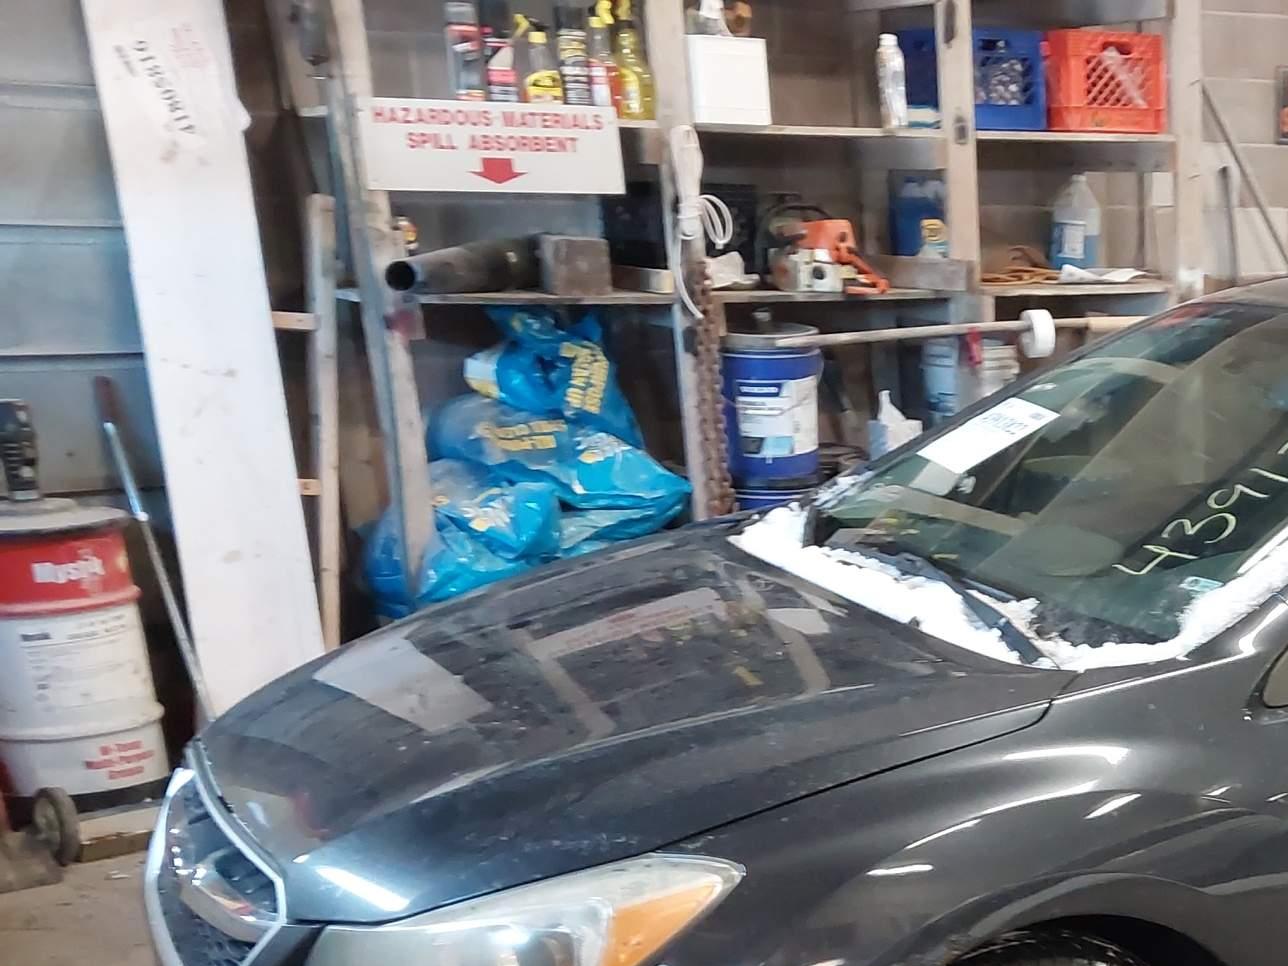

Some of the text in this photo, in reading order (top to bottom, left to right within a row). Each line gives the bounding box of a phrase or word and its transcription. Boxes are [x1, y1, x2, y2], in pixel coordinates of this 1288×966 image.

[371, 106, 604, 130] HAZARDOUS MATERIALS
[406, 132, 578, 153] SPILL ABSORBENT
